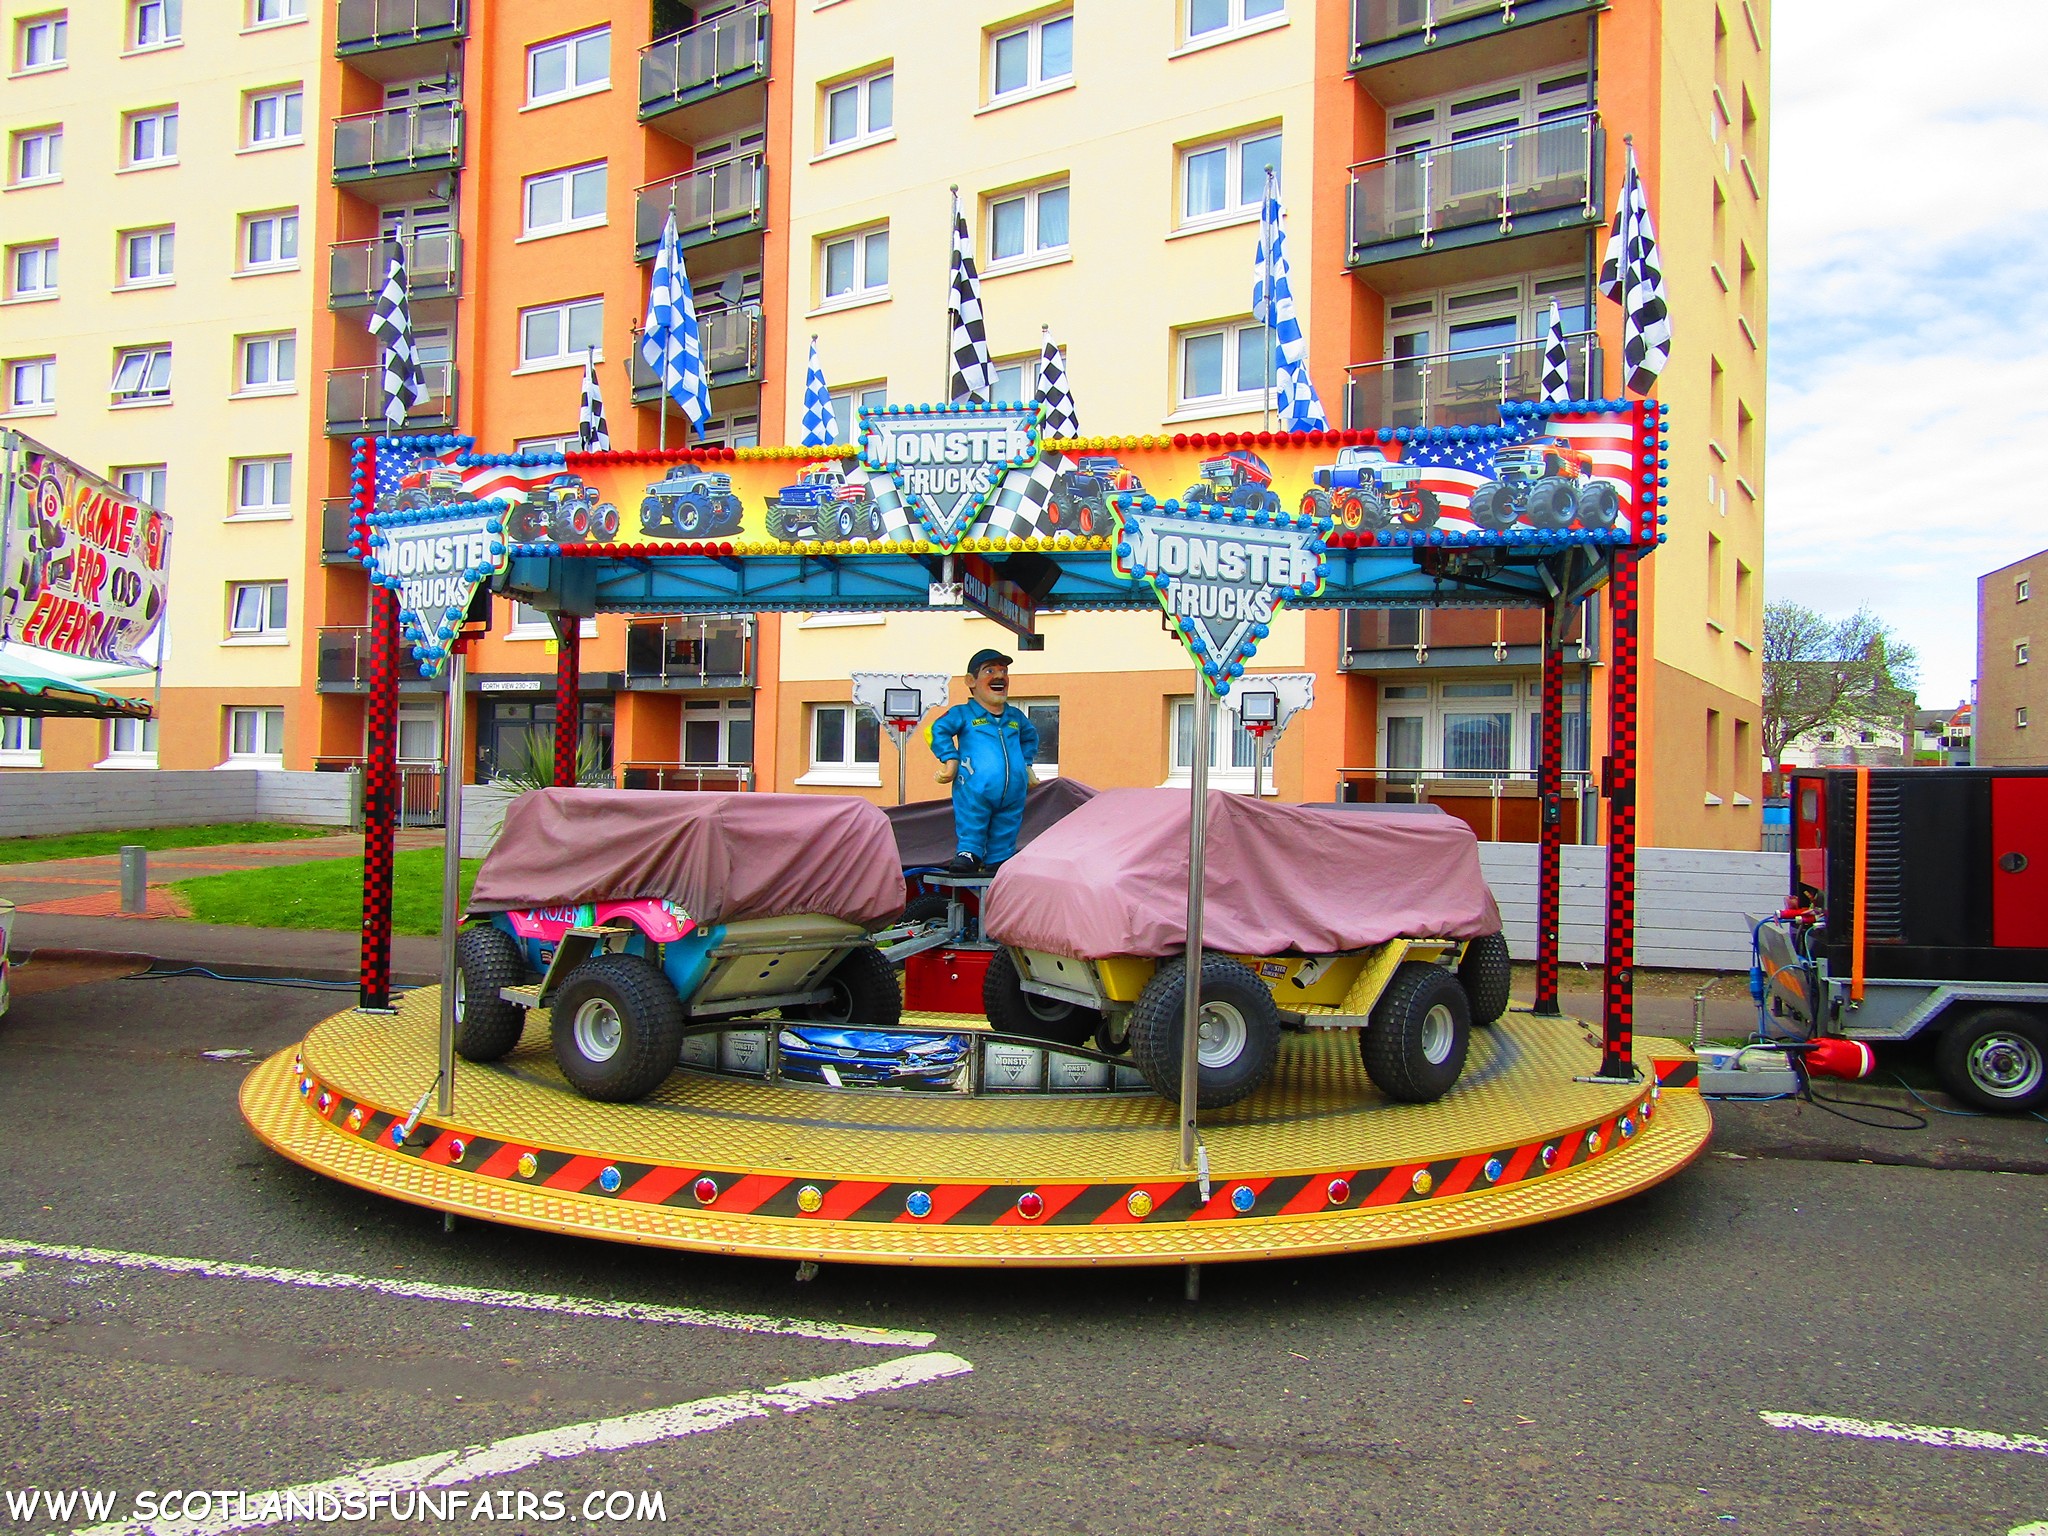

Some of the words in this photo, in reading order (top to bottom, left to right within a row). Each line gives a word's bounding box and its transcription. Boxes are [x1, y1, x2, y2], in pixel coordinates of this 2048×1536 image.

[867, 431, 1030, 463] MONSTER
[900, 467, 992, 495] TRUCKS
[76, 486, 139, 557] GAME
[73, 543, 108, 606] FOR
[1121, 529, 1318, 589] MONSTER
[400, 576, 469, 610] TRUCKS
[963, 572, 987, 603] CHILD
[1167, 581, 1274, 624] TRUCKS
